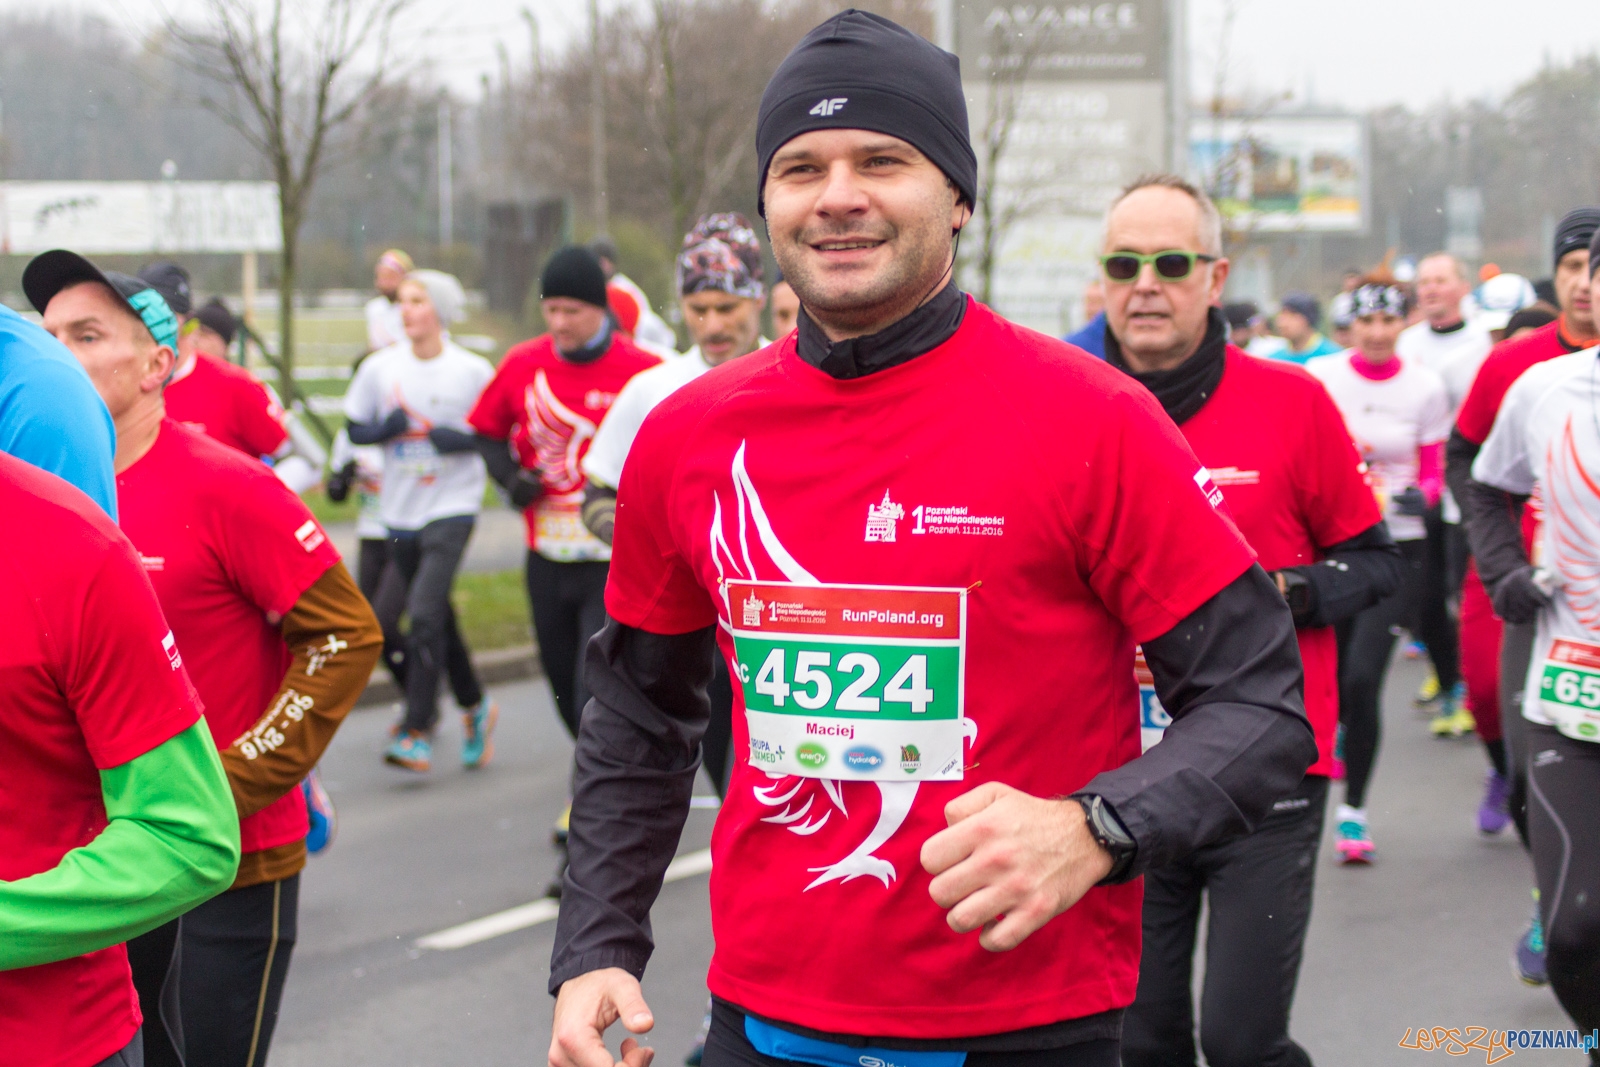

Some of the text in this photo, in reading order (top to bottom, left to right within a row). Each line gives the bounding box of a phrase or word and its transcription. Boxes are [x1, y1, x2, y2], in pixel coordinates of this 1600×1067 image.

[809, 97, 848, 117] 4F
[911, 504, 926, 535] 1
[925, 506, 968, 515] Poznański
[925, 515, 1005, 526] Bieg Niepodległości
[962, 526, 1004, 536] 11.11.2016
[842, 608, 944, 628] RunPoland.org
[754, 647, 935, 714] 4524
[1554, 671, 1600, 708] 65
[806, 722, 855, 740] Maciej
[800, 752, 826, 764] energy
